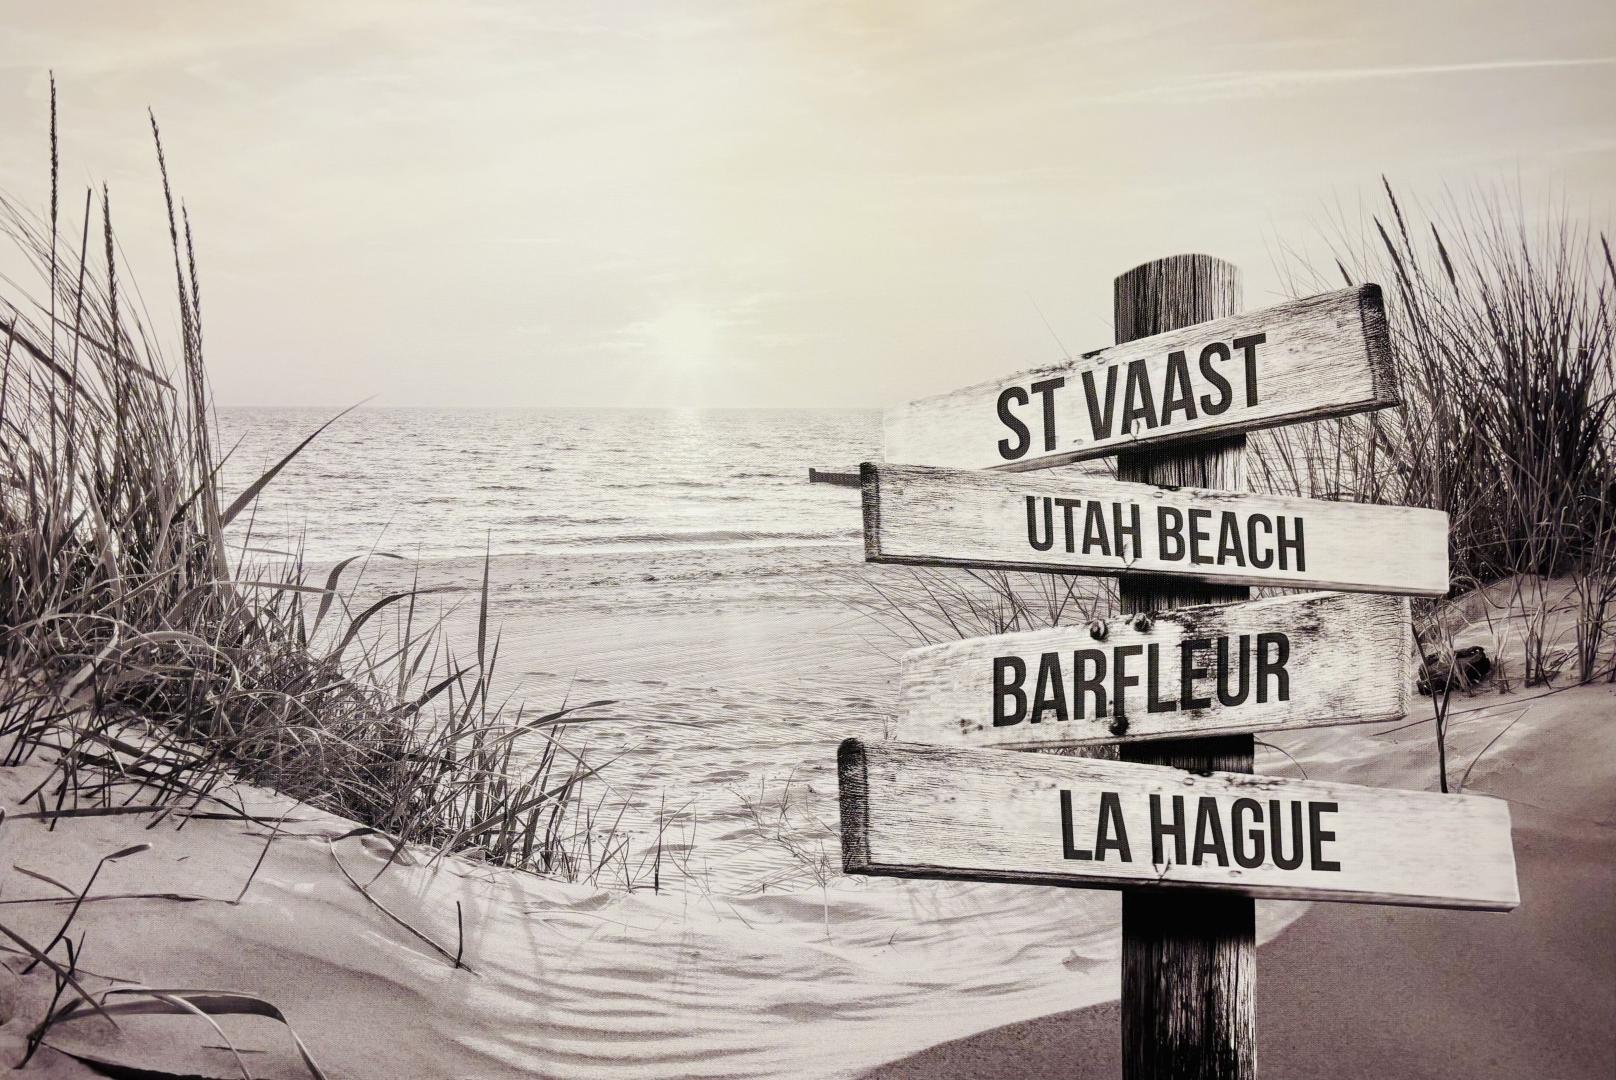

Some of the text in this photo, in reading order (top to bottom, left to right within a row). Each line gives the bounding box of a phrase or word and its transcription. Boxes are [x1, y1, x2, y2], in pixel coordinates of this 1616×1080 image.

[996, 332, 1266, 461] ST VAAST
[1026, 495, 1306, 572] UTAH BEACH
[992, 632, 1290, 726] BARFLEUR
[1060, 789, 1341, 871] LA HAGUE
